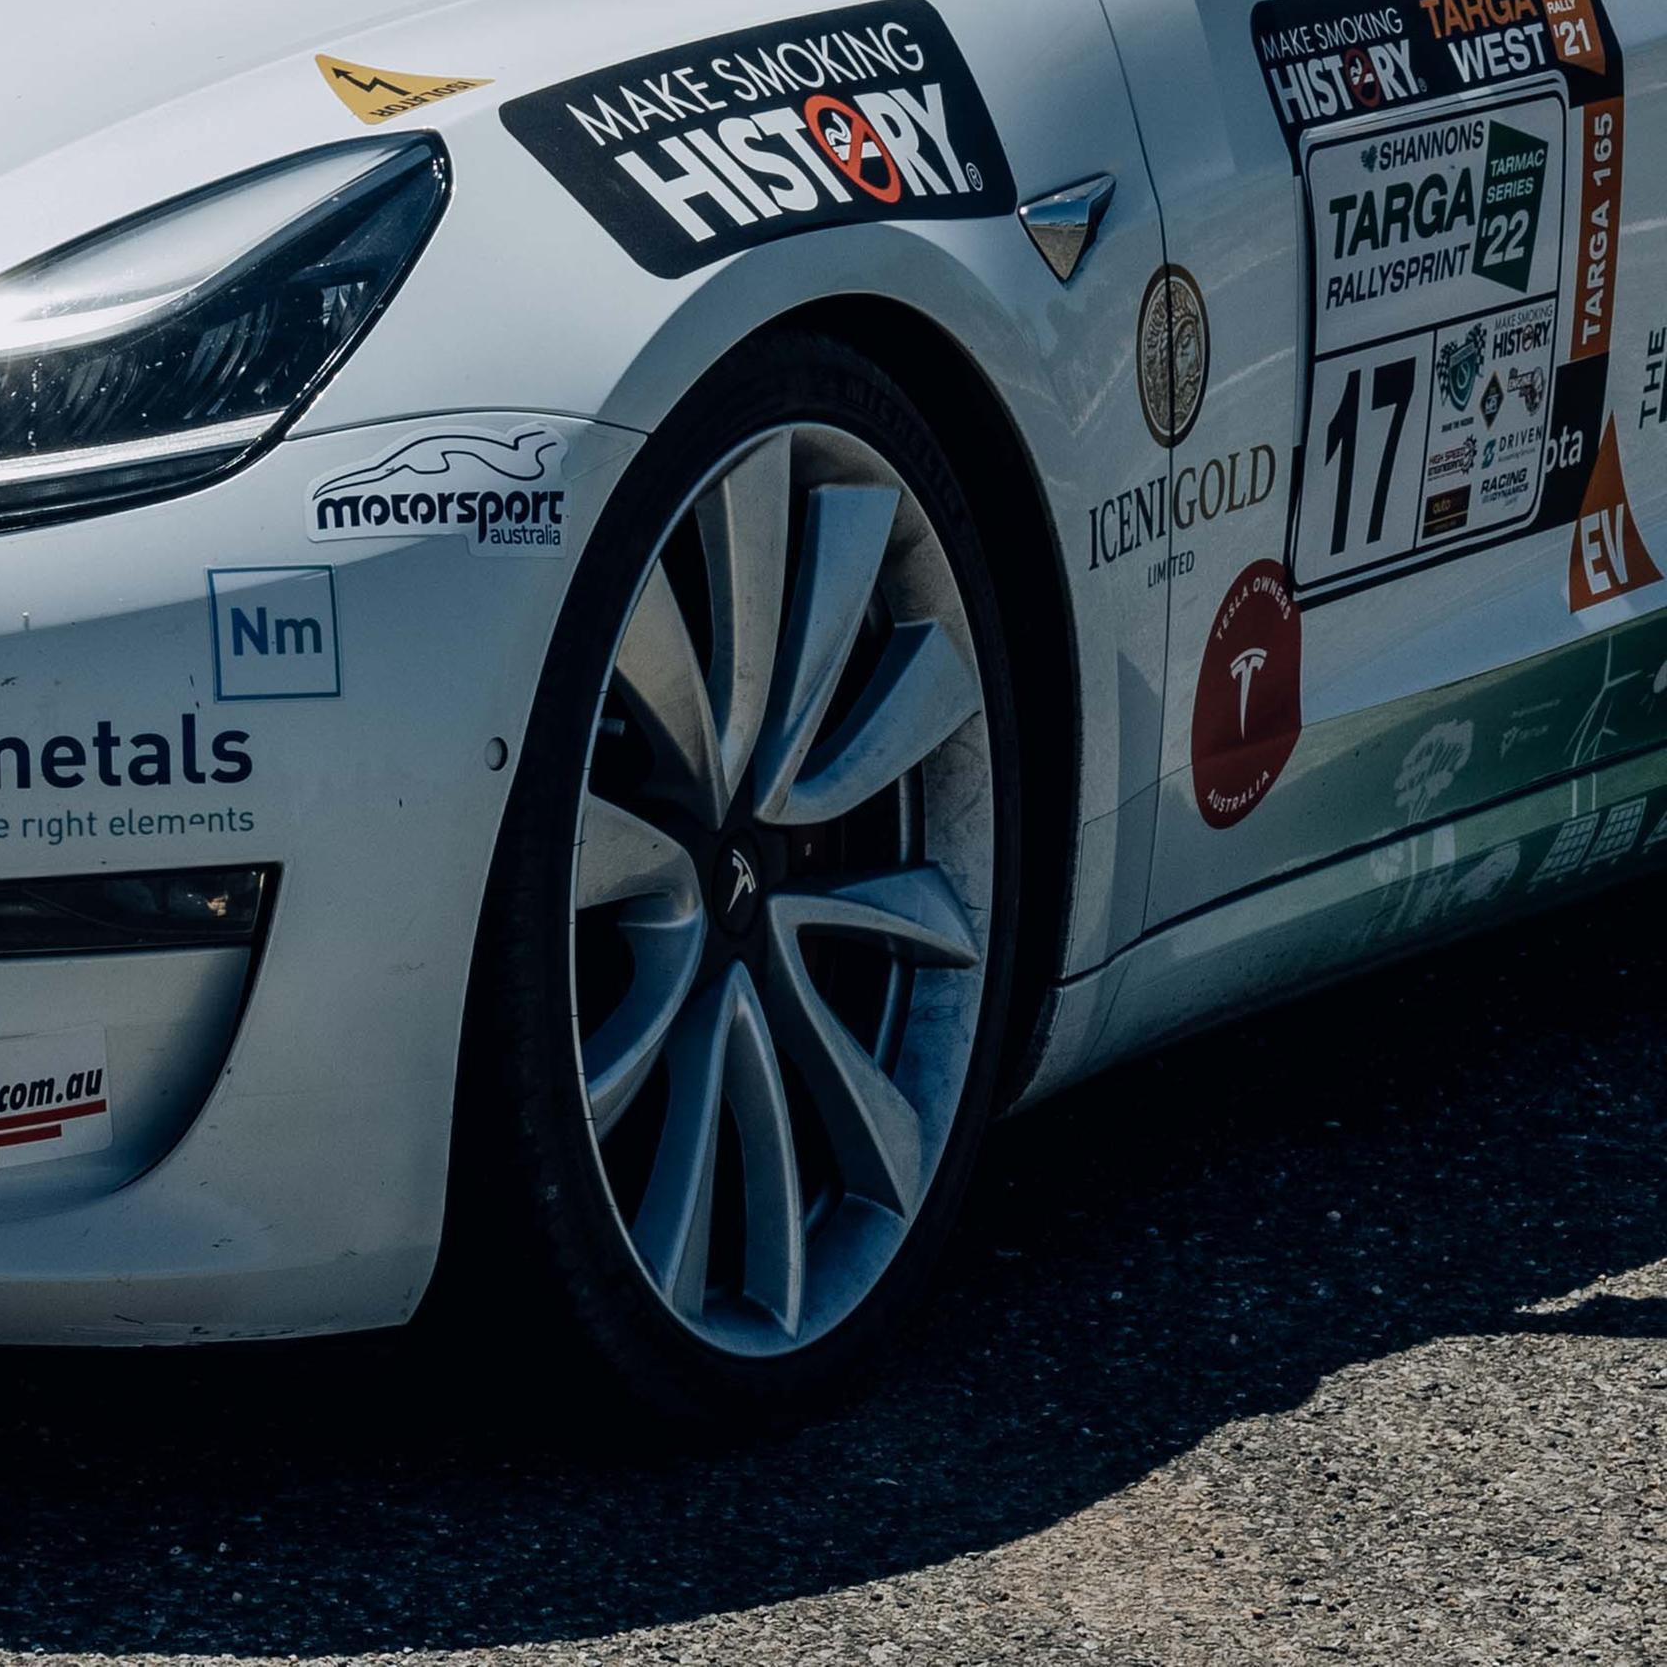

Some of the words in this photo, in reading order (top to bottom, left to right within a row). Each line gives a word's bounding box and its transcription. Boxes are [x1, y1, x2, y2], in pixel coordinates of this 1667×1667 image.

[1259, 25, 1316, 62] MAKE
[1316, 7, 1404, 51] SMOKING
[1447, 22, 1546, 84] WEST
[368, 79, 477, 119] ISOLATOR
[566, 66, 728, 146] MAKE
[712, 22, 925, 103] SMOKING
[1378, 119, 1485, 171] SHANNONS
[1490, 148, 1545, 178] TARMAC
[1592, 112, 1614, 186] 165
[1328, 166, 1476, 260] TARGA
[1485, 176, 1535, 204] SERIES
[1325, 242, 1471, 310] RALLYSPRINT
[1581, 199, 1612, 346] TARGA
[1322, 355, 1417, 557] 17
[1480, 468, 1528, 495] RACING
[316, 489, 565, 543] motorsport
[490, 524, 561, 545] australia
[1580, 503, 1629, 595] EV
[230, 606, 322, 656] Nm
[1216, 584, 1249, 641] TESLA
[1252, 576, 1292, 622] OWNERS
[1207, 769, 1271, 814] AUSTRALIA
[21, 810, 98, 846] right
[108, 806, 256, 837] elements
